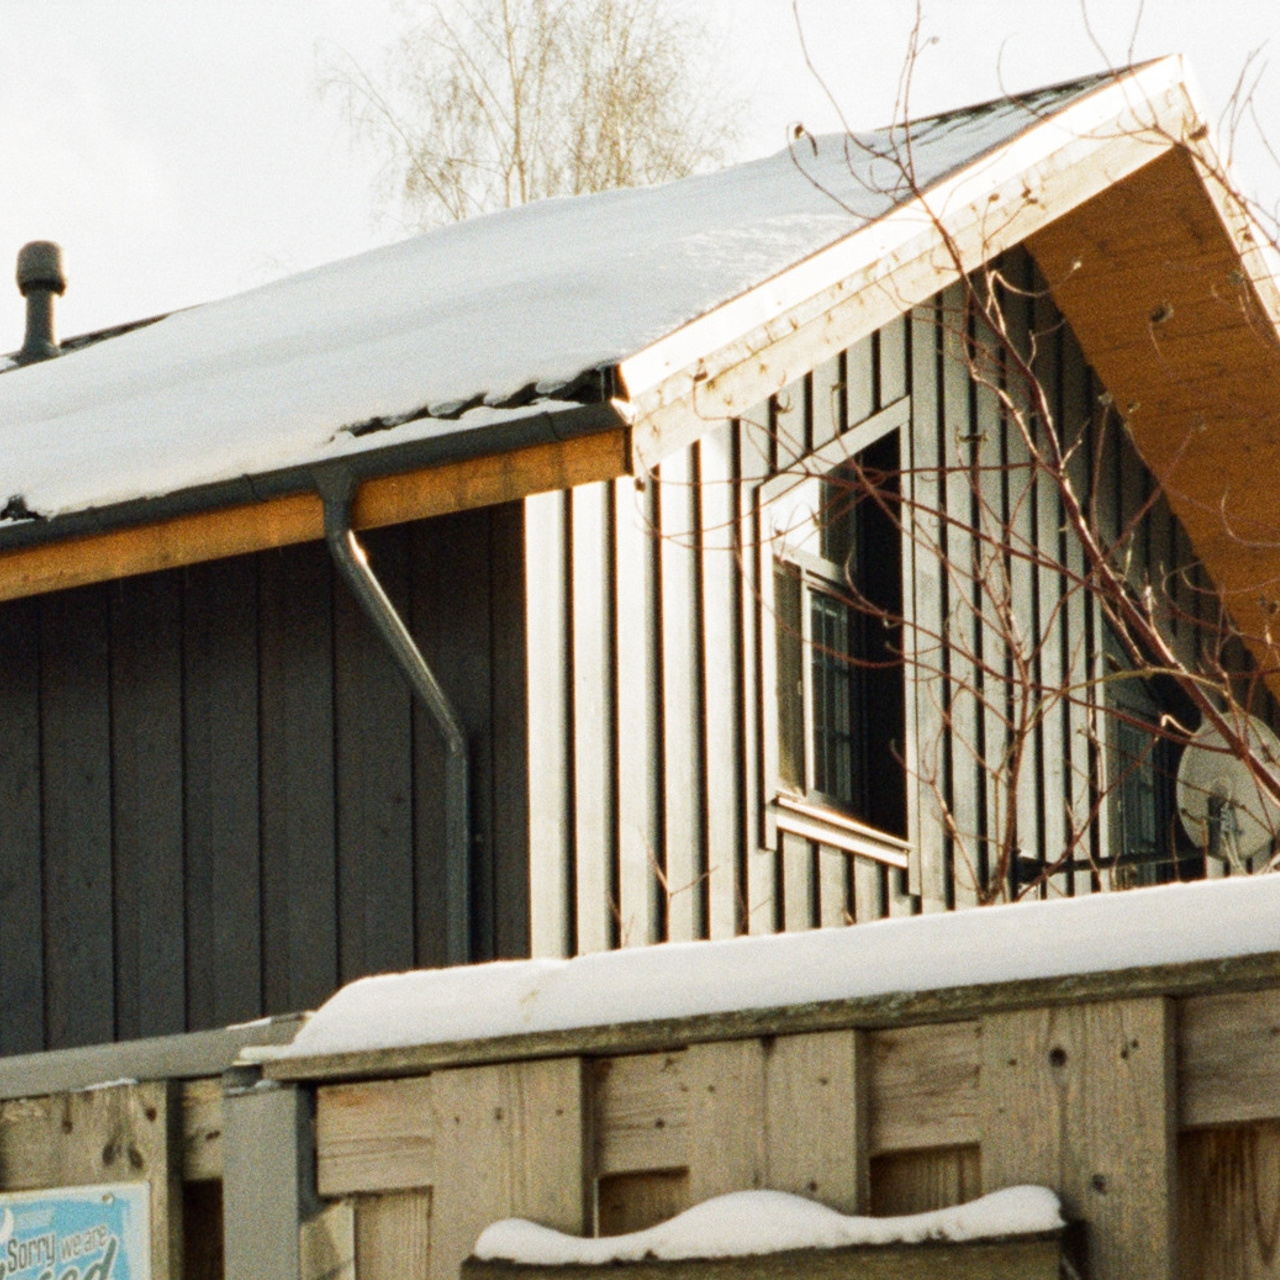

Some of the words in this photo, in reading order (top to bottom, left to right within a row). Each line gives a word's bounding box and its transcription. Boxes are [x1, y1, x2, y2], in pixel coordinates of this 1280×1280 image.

[6, 1232, 57, 1273] Sorry
[60, 1238, 83, 1260] we
[83, 1225, 108, 1252] are
